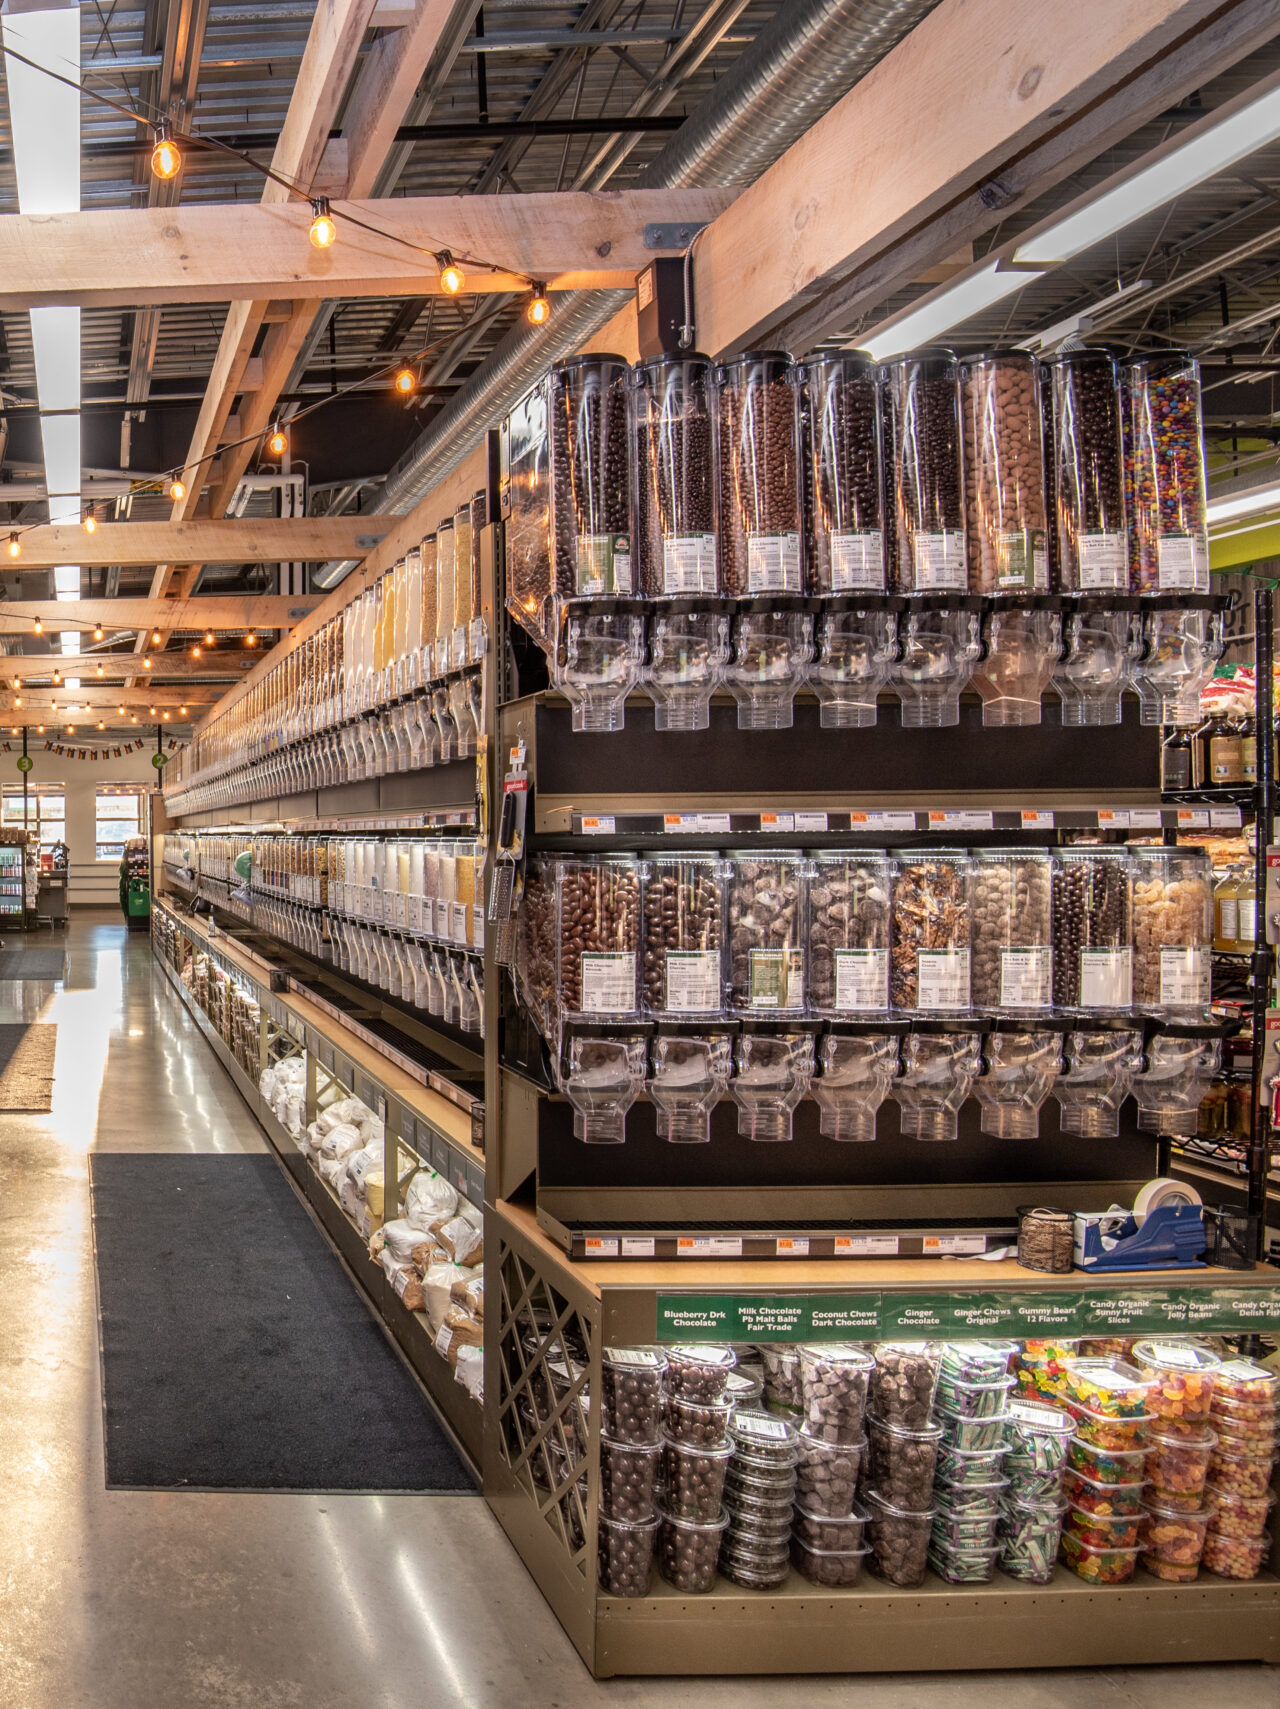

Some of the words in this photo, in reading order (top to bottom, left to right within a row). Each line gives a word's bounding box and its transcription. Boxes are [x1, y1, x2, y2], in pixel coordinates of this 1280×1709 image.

[21, 759, 29, 770] 3
[156, 755, 165, 767] 2
[1090, 1301, 1117, 1309] Candy
[1118, 1300, 1150, 1308] Organic
[1161, 1303, 1187, 1312] Candy
[1189, 1302, 1221, 1311] Organic
[1232, 1301, 1258, 1310] Candy
[663, 1310, 707, 1320] Blueberry
[709, 1310, 726, 1319] Drk
[738, 1307, 758, 1315] Milk
[759, 1307, 802, 1315] Chocolate
[812, 1311, 848, 1319] Coconut
[850, 1310, 878, 1318] Chews
[904, 1309, 934, 1318] Ginger
[954, 1309, 982, 1317] Ginger
[983, 1308, 1012, 1316] Chews
[1018, 1307, 1051, 1316] Gummy
[1053, 1307, 1077, 1315] Bears
[1095, 1308, 1121, 1317] Sunny
[1122, 1308, 1144, 1316] Fruit
[1167, 1311, 1187, 1320] Jolly
[1188, 1310, 1213, 1318] Beans
[1239, 1309, 1265, 1317] Delish
[673, 1319, 717, 1327] Chocolate
[742, 1315, 753, 1323] Pb
[777, 1315, 798, 1323] Balls
[812, 1319, 833, 1327] Dark
[835, 1318, 877, 1326] Chocolate
[897, 1317, 940, 1325] Chocolate
[966, 1316, 999, 1325] Original
[1027, 1315, 1037, 1323] 12
[1038, 1315, 1068, 1323] Flavors
[1107, 1316, 1131, 1324] Slices
[747, 1323, 764, 1331] Fair
[767, 1323, 792, 1331] Trade
